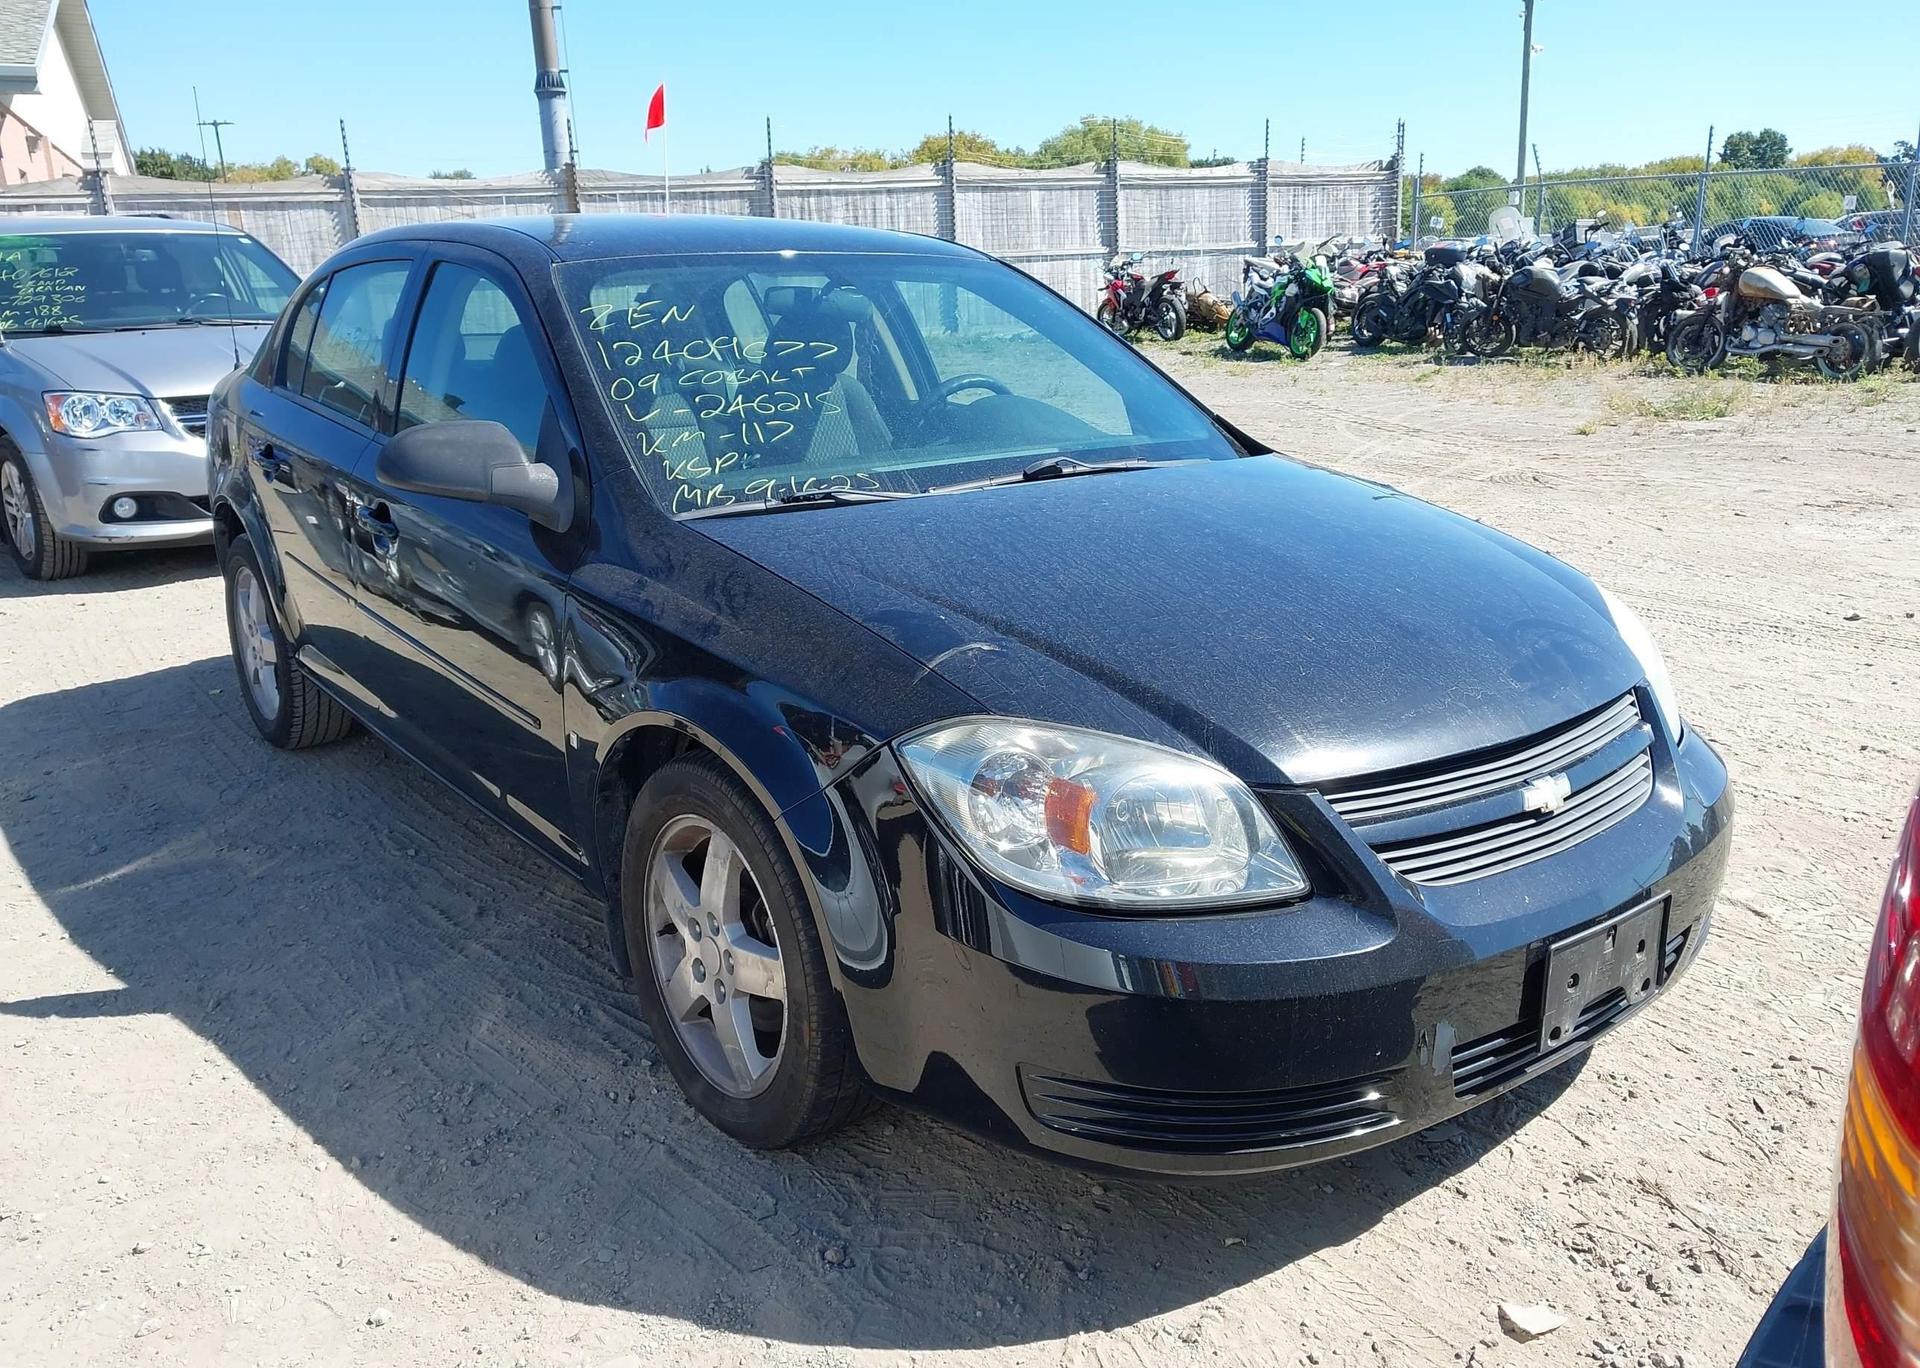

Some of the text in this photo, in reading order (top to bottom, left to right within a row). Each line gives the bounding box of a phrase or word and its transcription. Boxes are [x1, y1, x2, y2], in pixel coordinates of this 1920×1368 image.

[580, 300, 695, 330] ZEN
[610, 366, 816, 401] 09 COBALT
